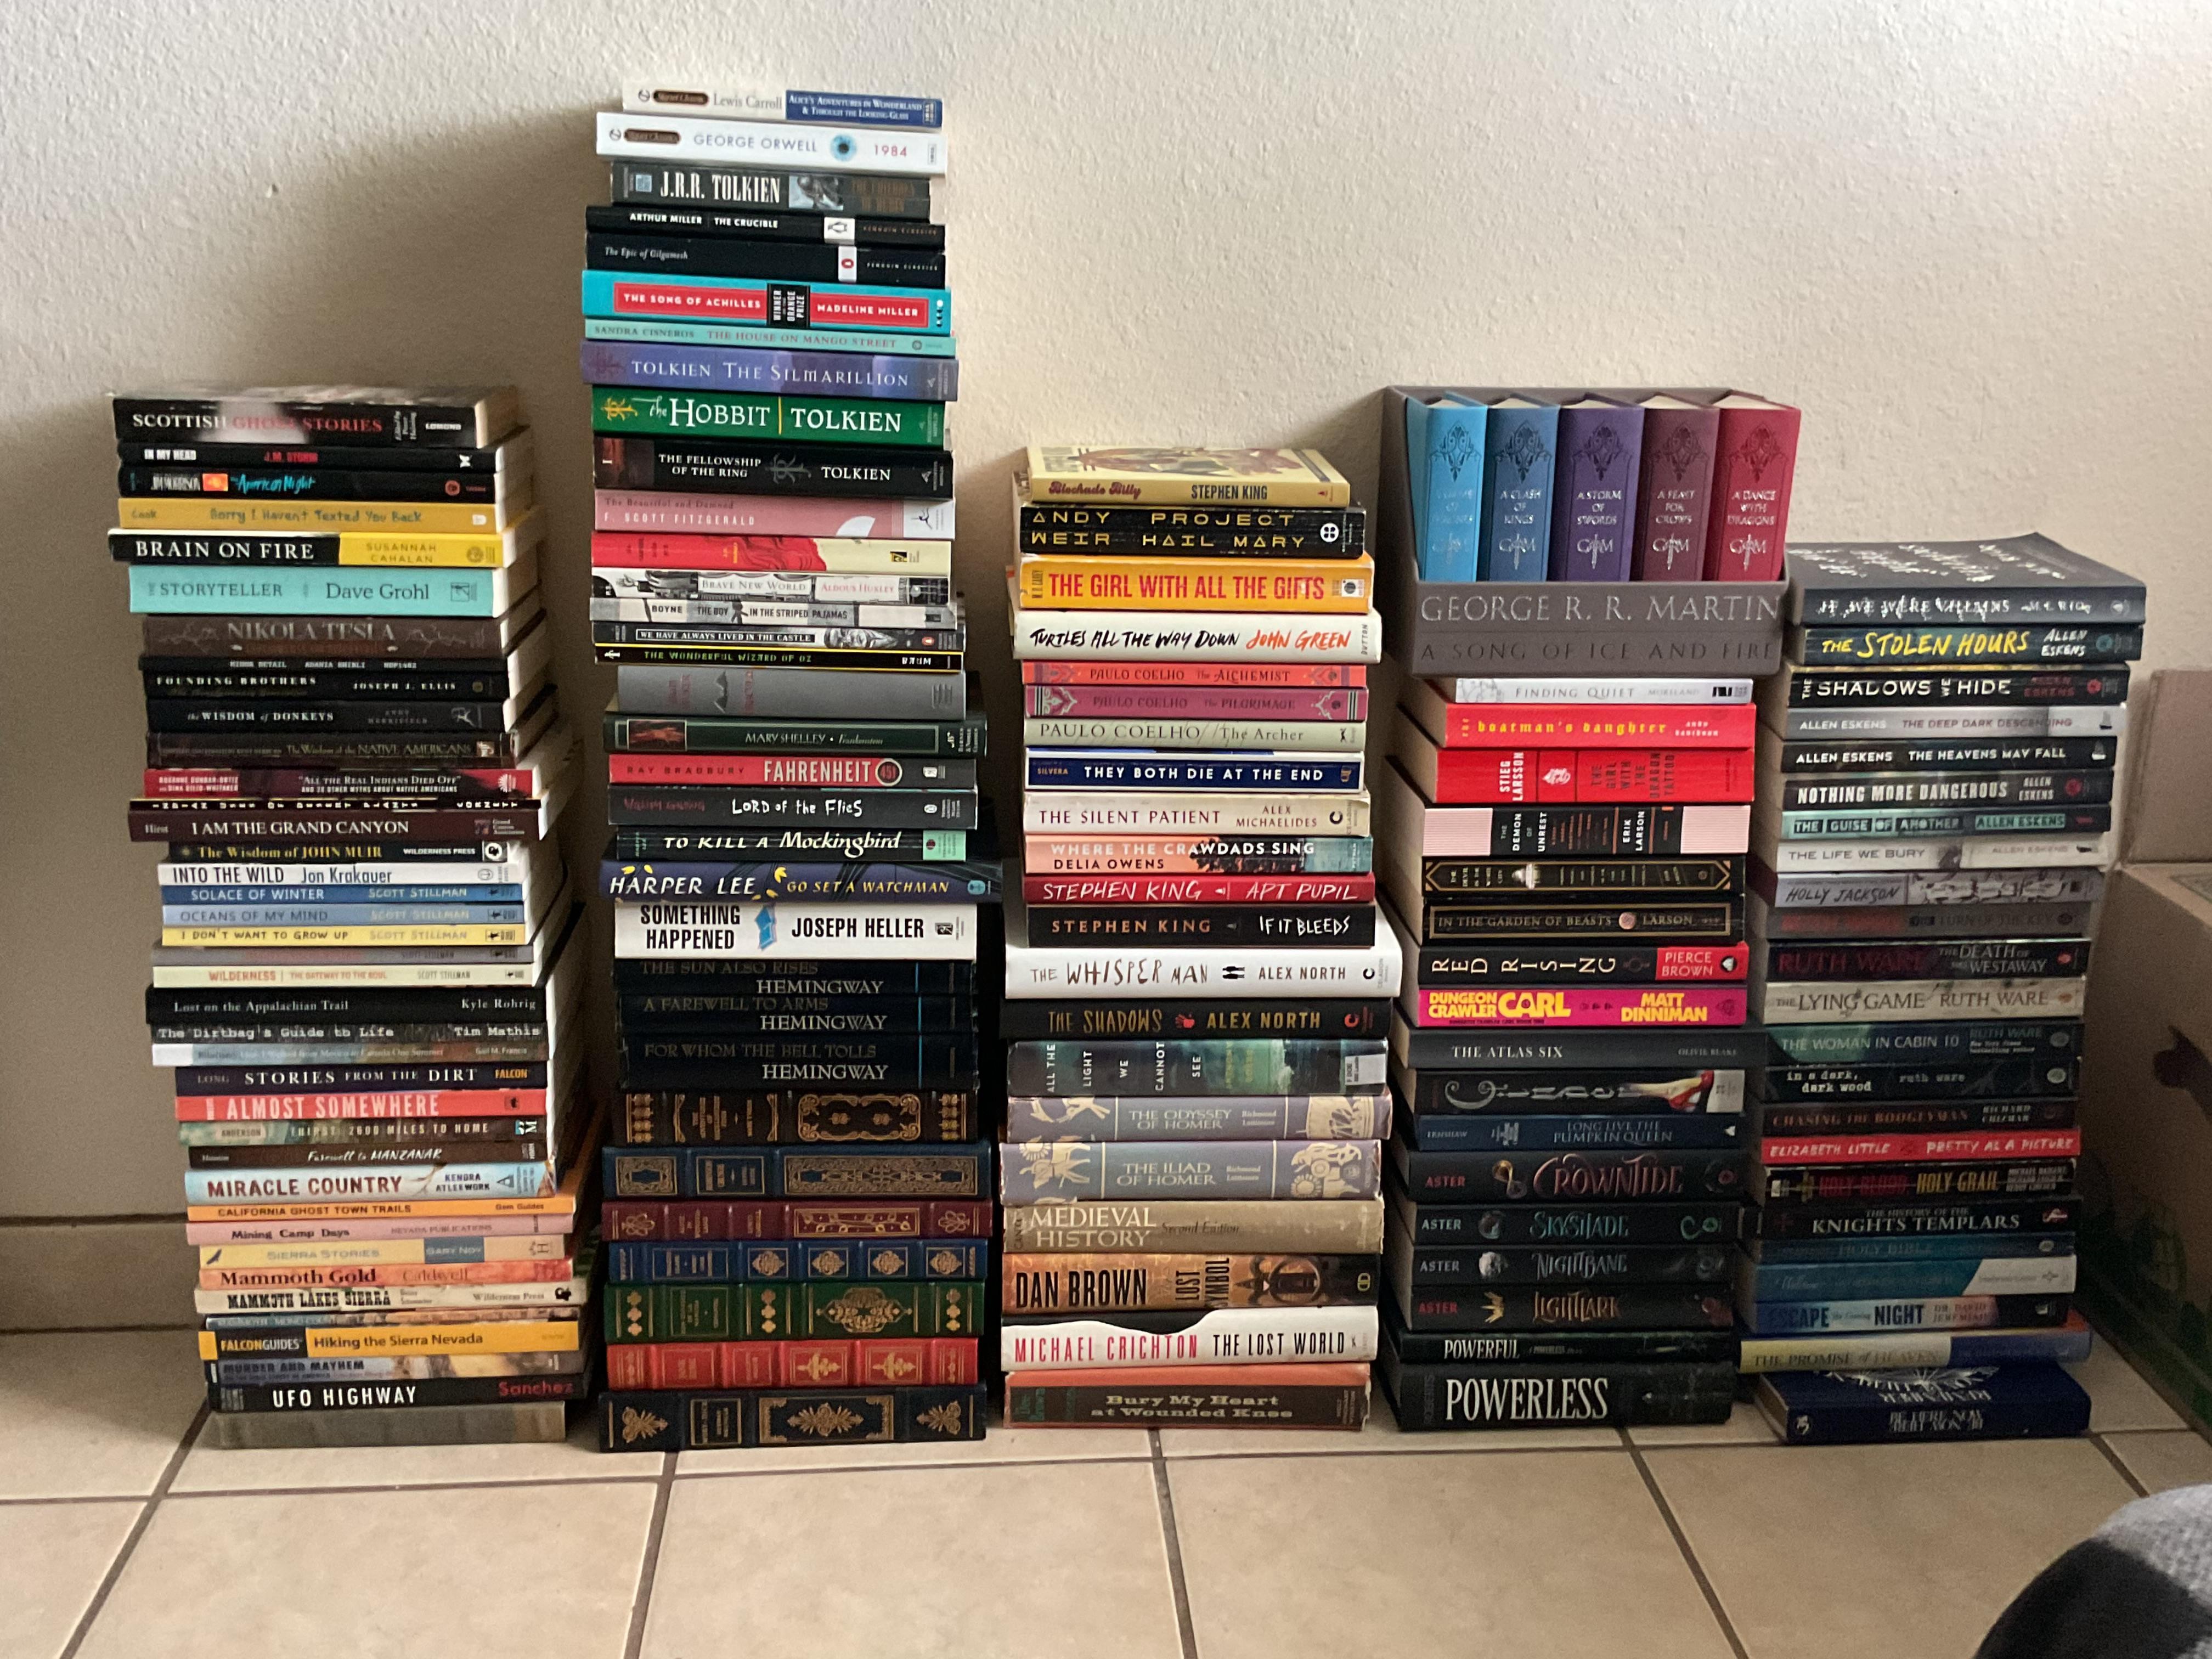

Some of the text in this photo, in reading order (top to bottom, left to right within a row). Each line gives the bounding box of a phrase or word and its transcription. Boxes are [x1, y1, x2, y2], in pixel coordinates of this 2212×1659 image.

[713, 94, 742, 108] Lewis
[746, 95, 782, 110] Carroll
[693, 133, 754, 149] GEORGE
[761, 137, 817, 153] ORWELL
[874, 145, 907, 157] 1984
[661, 171, 781, 203] J.R.R. TOLKIEN
[630, 213, 702, 224] ARTHUR MILLER
[714, 217, 778, 228] THE CRUCIBLE
[605, 247, 688, 260] The Epic of Gilgamesh
[624, 294, 760, 309] THE SONG OF ACHILLES
[817, 304, 919, 317] MADELINE MILLER
[631, 361, 711, 376] TOLKIEN
[723, 362, 909, 387] THE SILMARILLION
[669, 398, 770, 427] HOBBIT
[791, 408, 901, 432] TOLKIEN
[315, 510, 359, 522] Texted
[366, 511, 386, 522] You
[392, 511, 422, 522] Back
[1032, 511, 1110, 523] ANDY
[1152, 513, 1294, 526] PROJECT
[1032, 532, 1110, 545] WEIR
[1143, 534, 1305, 548] HAIL MARY
[136, 541, 314, 560] BRAIN ON FIRE
[366, 543, 437, 553] SUSANNAH
[160, 584, 282, 596] STORYTELLER
[326, 583, 429, 600] Dave Grohl
[702, 580, 806, 591] BRAVE NEW WORLD
[822, 582, 894, 594] ALDOUS HUXLEY
[1421, 596, 1780, 622] GEORGE R. R. MARTIN
[2044, 629, 2087, 642] ALLEN
[1822, 631, 2030, 658] THE STOLEN HOURS
[2041, 644, 2085, 656] ESKENS
[1817, 681, 1931, 696] SHADOWS
[1957, 680, 2011, 695] HIDE
[202, 712, 255, 720] WISDOM
[260, 712, 269, 723] of
[273, 713, 334, 721] DONKEYS
[1041, 724, 1200, 740] PAULO COELHO
[1220, 728, 1304, 741] The Archer
[1796, 752, 1893, 763] ALLEN ESKENS
[1909, 748, 2066, 760] THE HEAVENS MAY FALL
[764, 760, 871, 784] FAHRENHEIT
[1085, 767, 1323, 780] THEY BOTH DIE AT THE END
[1040, 810, 1220, 824] THE SILENT PATIENT
[1262, 805, 1291, 815] ALEX
[1236, 817, 1317, 827] MICHAELIDES
[1622, 819, 1630, 844] ERIK
[1788, 849, 1926, 860] THE LIFE WE BURY
[1054, 859, 1164, 869] DELIA OWENS
[173, 867, 284, 883] INTO THE WILD
[301, 867, 392, 883] Jon Krakauer
[191, 889, 324, 900] SOLACE OF WINTER
[369, 888, 467, 898] SCOTT STILLMAN
[1786, 887, 1901, 903] HOLLY JACKSON
[757, 980, 883, 994] HEMINGWAY
[461, 999, 536, 1011] Kyle Rohrig
[1430, 992, 1497, 1004] DUNGEON
[1498, 992, 1571, 1017] CARL
[1641, 992, 1685, 1007] MATT
[1798, 993, 1861, 1012] LYING
[1864, 993, 1925, 1008] GAME
[1939, 991, 2049, 1007] RUTH WARE
[1429, 1005, 1497, 1018] CRAWLER
[1621, 1006, 1707, 1022] DINNIMAN
[1452, 1046, 1563, 1058] THE ATLAS SIX
[1082, 1051, 1092, 1087] LIGHT
[1155, 1041, 1165, 1091] CANNOT
[227, 1095, 438, 1120] ALMOST SOMEWHERE
[207, 1176, 402, 1197] MIRACLE COUNTRY
[1421, 1219, 1462, 1231] ASTER
[1813, 1214, 2020, 1233] KNIGHTS TEMPLARS
[221, 1339, 300, 1351] FALCONGUIDES
[314, 1335, 360, 1349] Hiking
[390, 1335, 427, 1346] Sierra
[431, 1334, 483, 1345] Nevada
[1015, 1334, 1198, 1363] MICHAEL CRICHTON
[1213, 1332, 1345, 1356] THE LOST WORLD
[1444, 1339, 1520, 1359] POWERFUL
[273, 1386, 416, 1407] UFO HIGHWAY
[1446, 1378, 1609, 1420] POWERLESS
